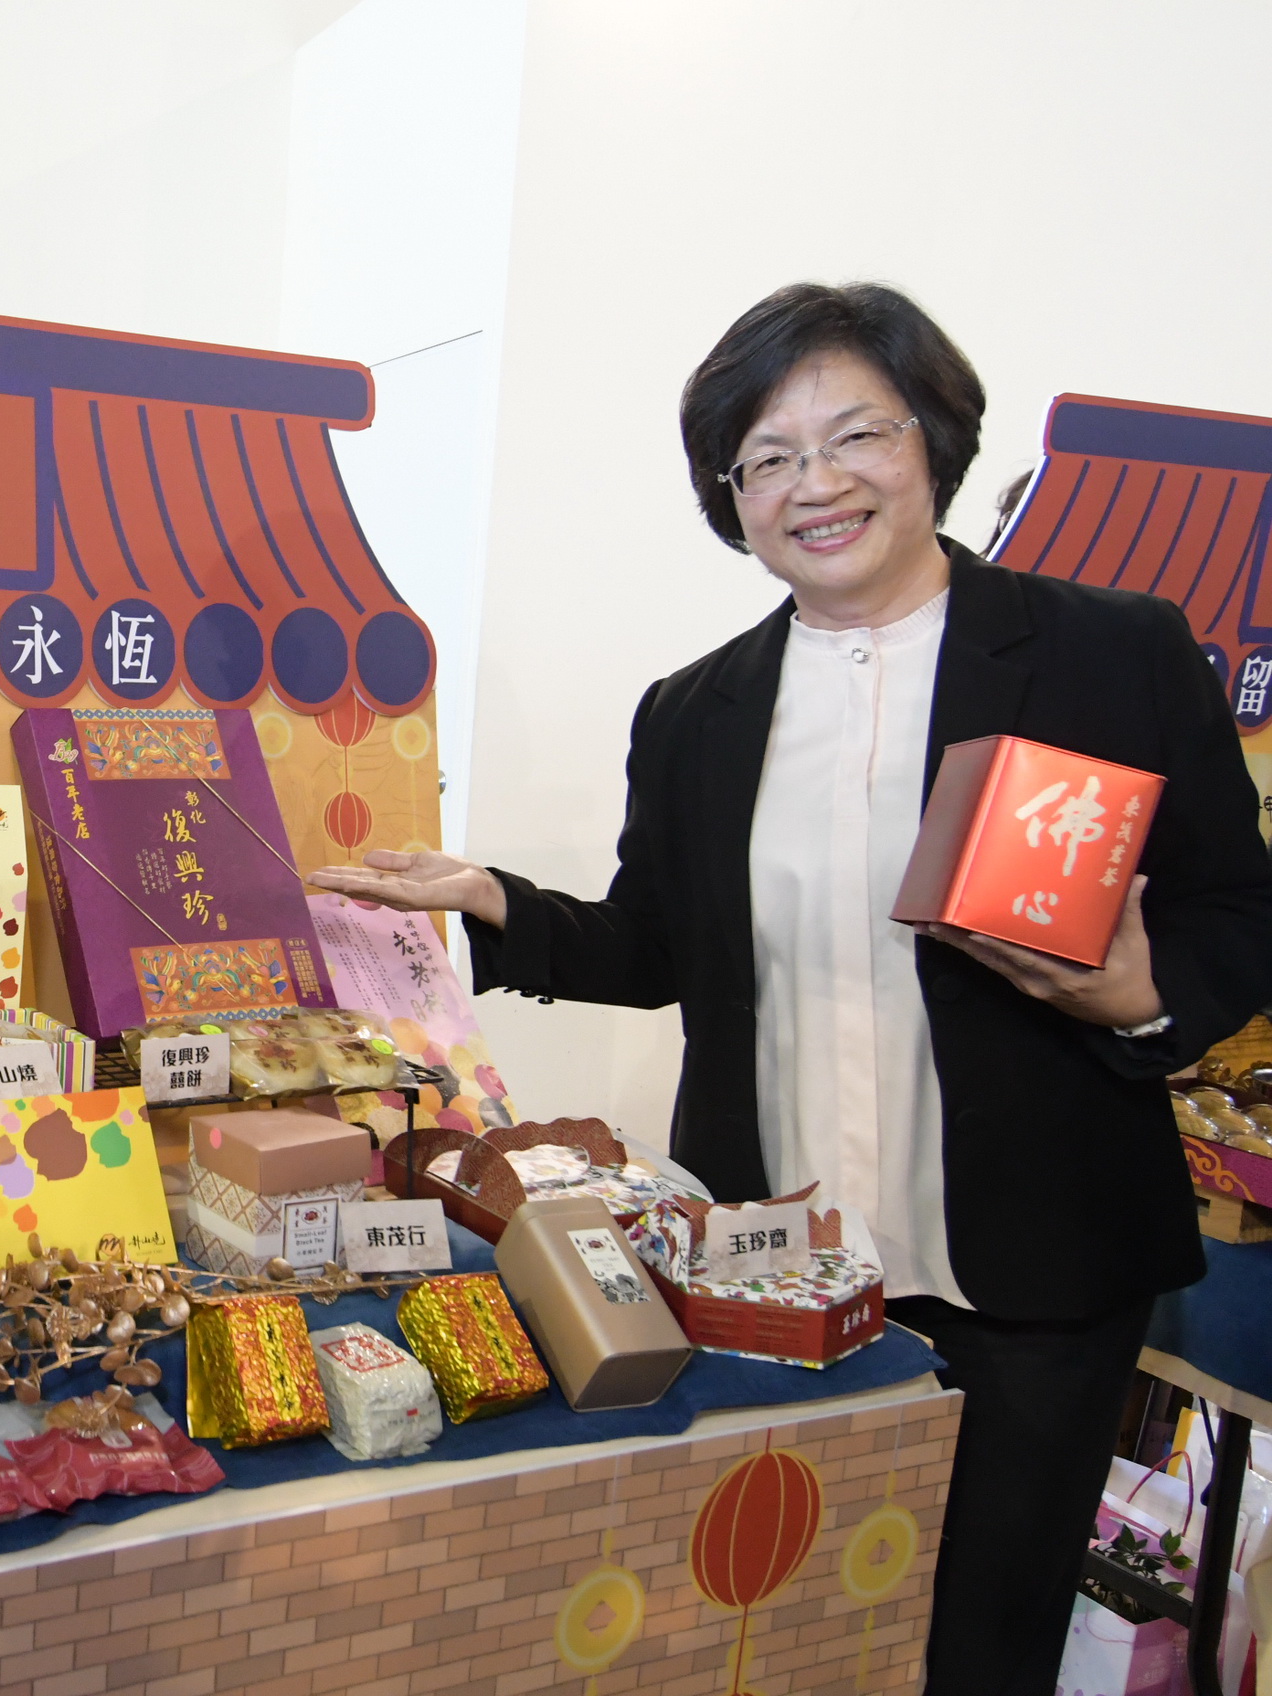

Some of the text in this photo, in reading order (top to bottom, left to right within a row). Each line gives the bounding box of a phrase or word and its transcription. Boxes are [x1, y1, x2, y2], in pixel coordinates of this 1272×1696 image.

[61, 768, 90, 839] 百年老店
[184, 790, 206, 824] 彰化
[1012, 775, 1106, 926] 佛心
[163, 808, 214, 926] 復興珍
[161, 1046, 210, 1067] 復興珍
[170, 1069, 203, 1090] 囍餅
[365, 1225, 427, 1247] 東茂行
[729, 1228, 788, 1255] 玉珍齋
